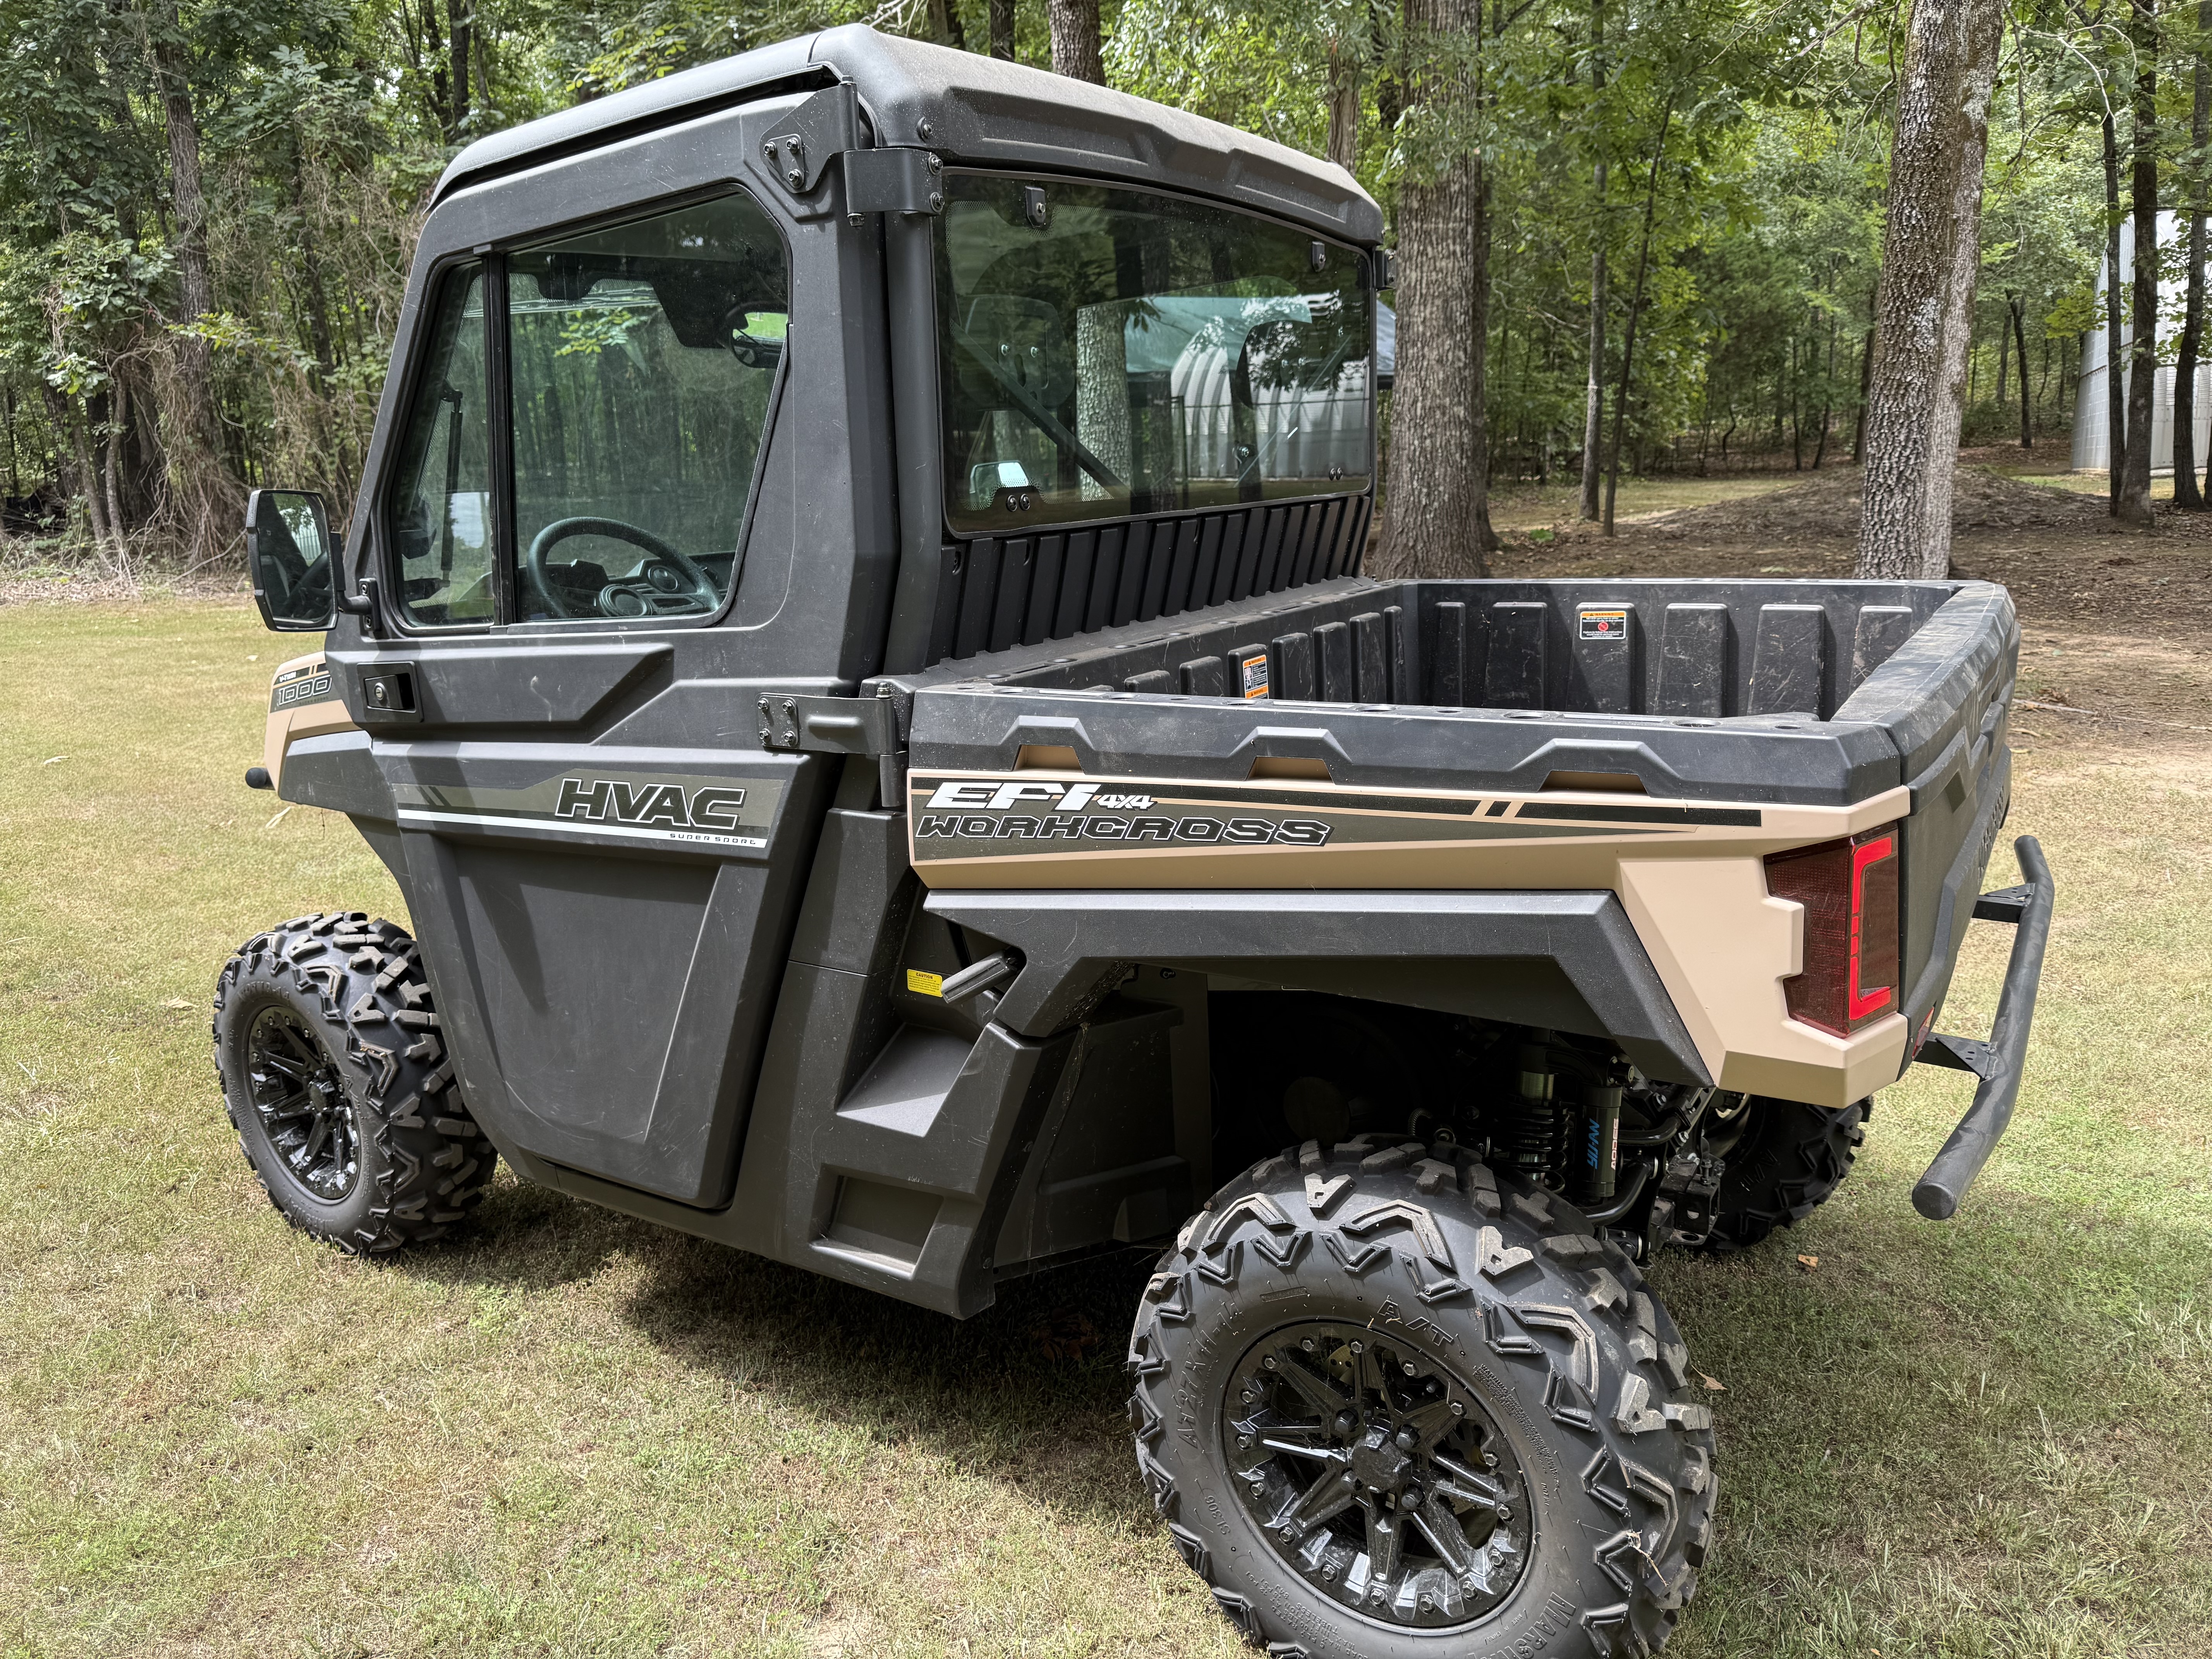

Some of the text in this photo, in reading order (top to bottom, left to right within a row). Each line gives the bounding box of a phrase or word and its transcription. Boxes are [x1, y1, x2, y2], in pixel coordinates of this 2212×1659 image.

[279, 675, 332, 705] 1000
[555, 778, 746, 830] HVAC
[926, 782, 1102, 811] EFI
[915, 816, 1331, 845] WORKCROSS
[1377, 1299, 1454, 1346] A/T
[1204, 1495, 1231, 1535] SL306
[1245, 1571, 1259, 1586] PSI
[1260, 1577, 1274, 1593] PSI
[1271, 1605, 1298, 1631] RATED
[1296, 1602, 1338, 1635] TUBELESS
[1300, 1630, 1317, 1644] PLY
